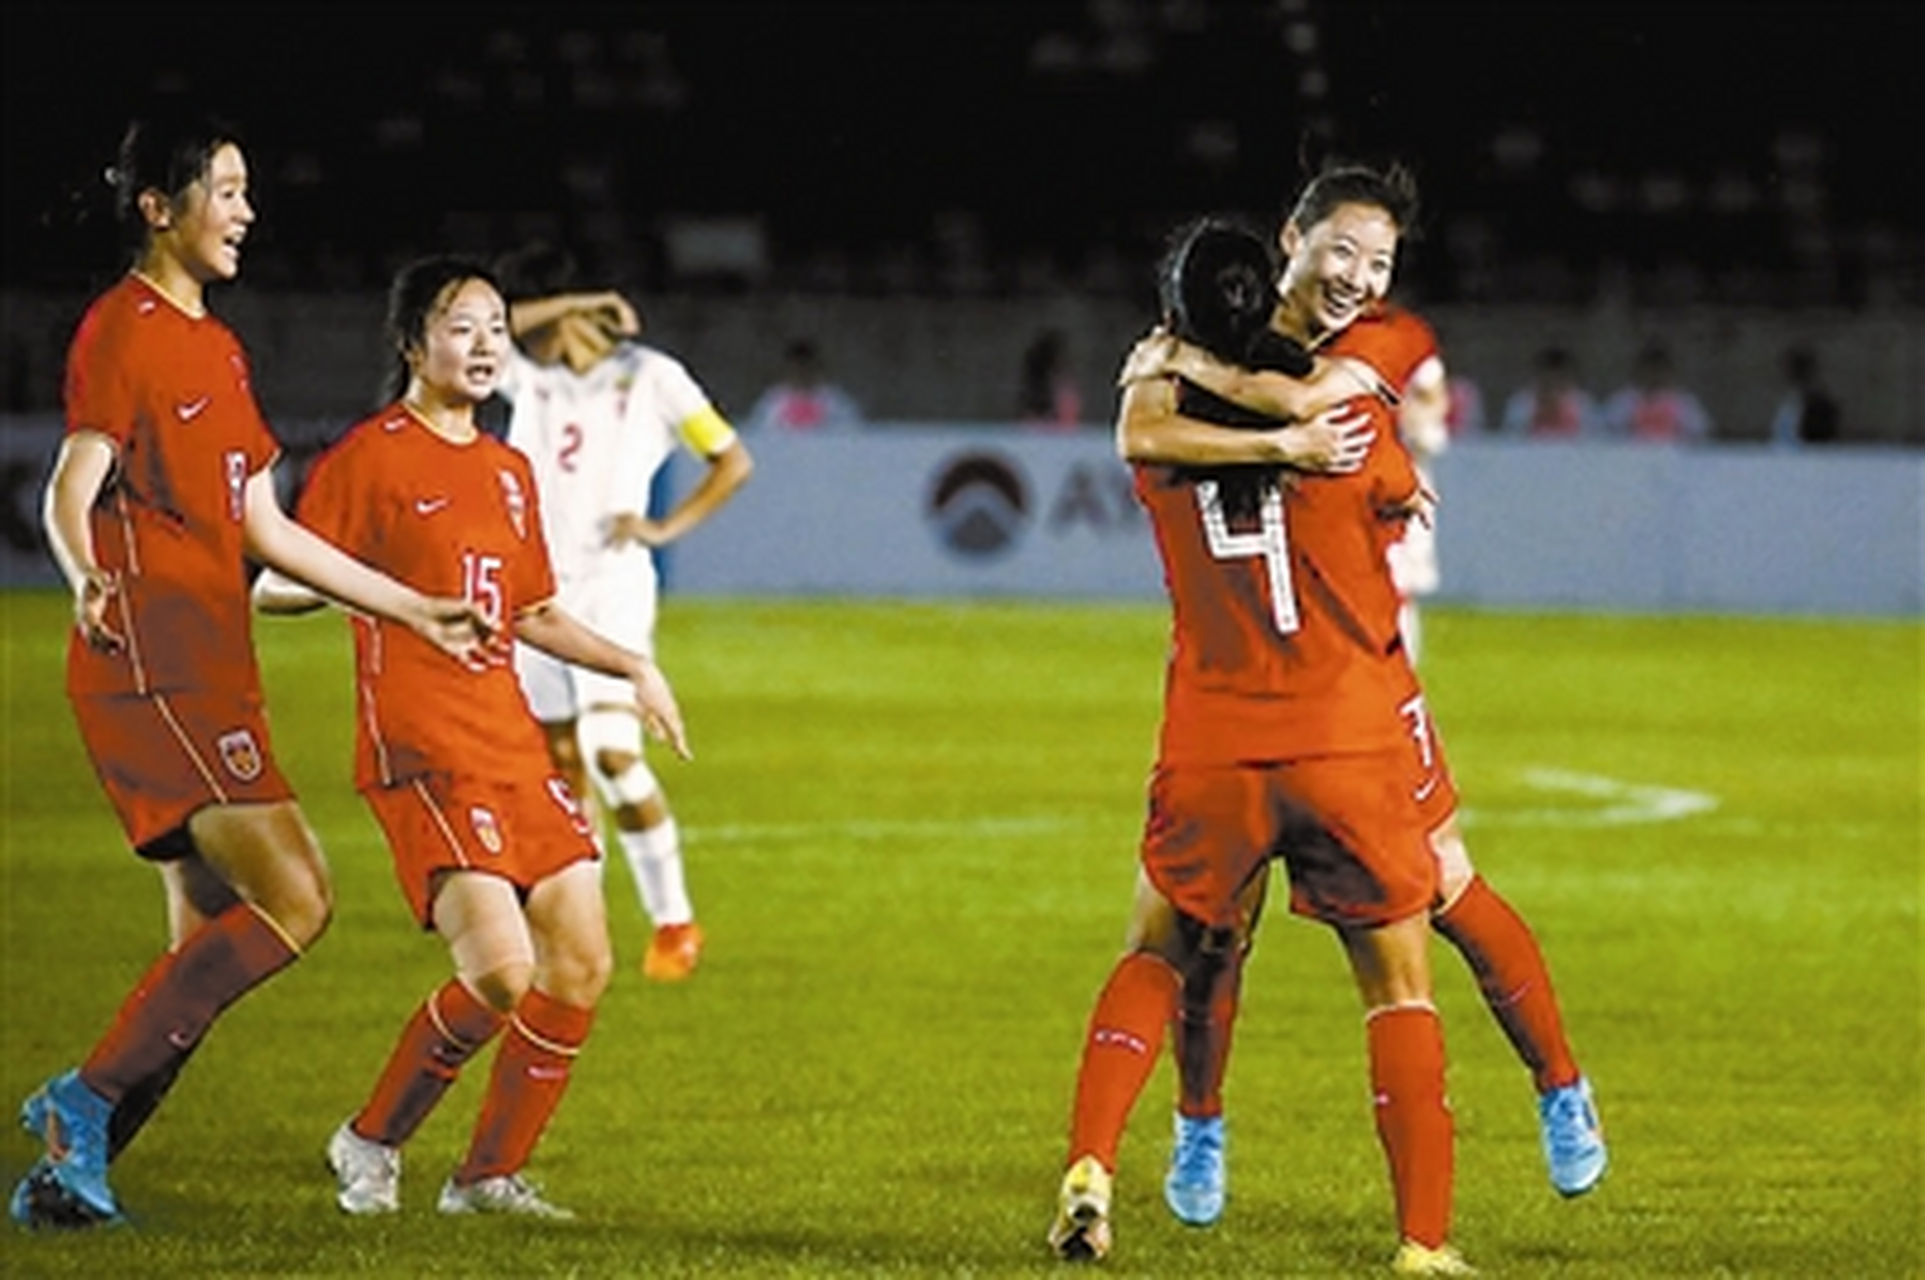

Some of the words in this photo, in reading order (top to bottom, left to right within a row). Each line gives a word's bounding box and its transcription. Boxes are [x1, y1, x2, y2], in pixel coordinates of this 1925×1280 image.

[558, 422, 584, 474] 2
[463, 554, 503, 625] 15
[1196, 480, 1299, 634] 4
